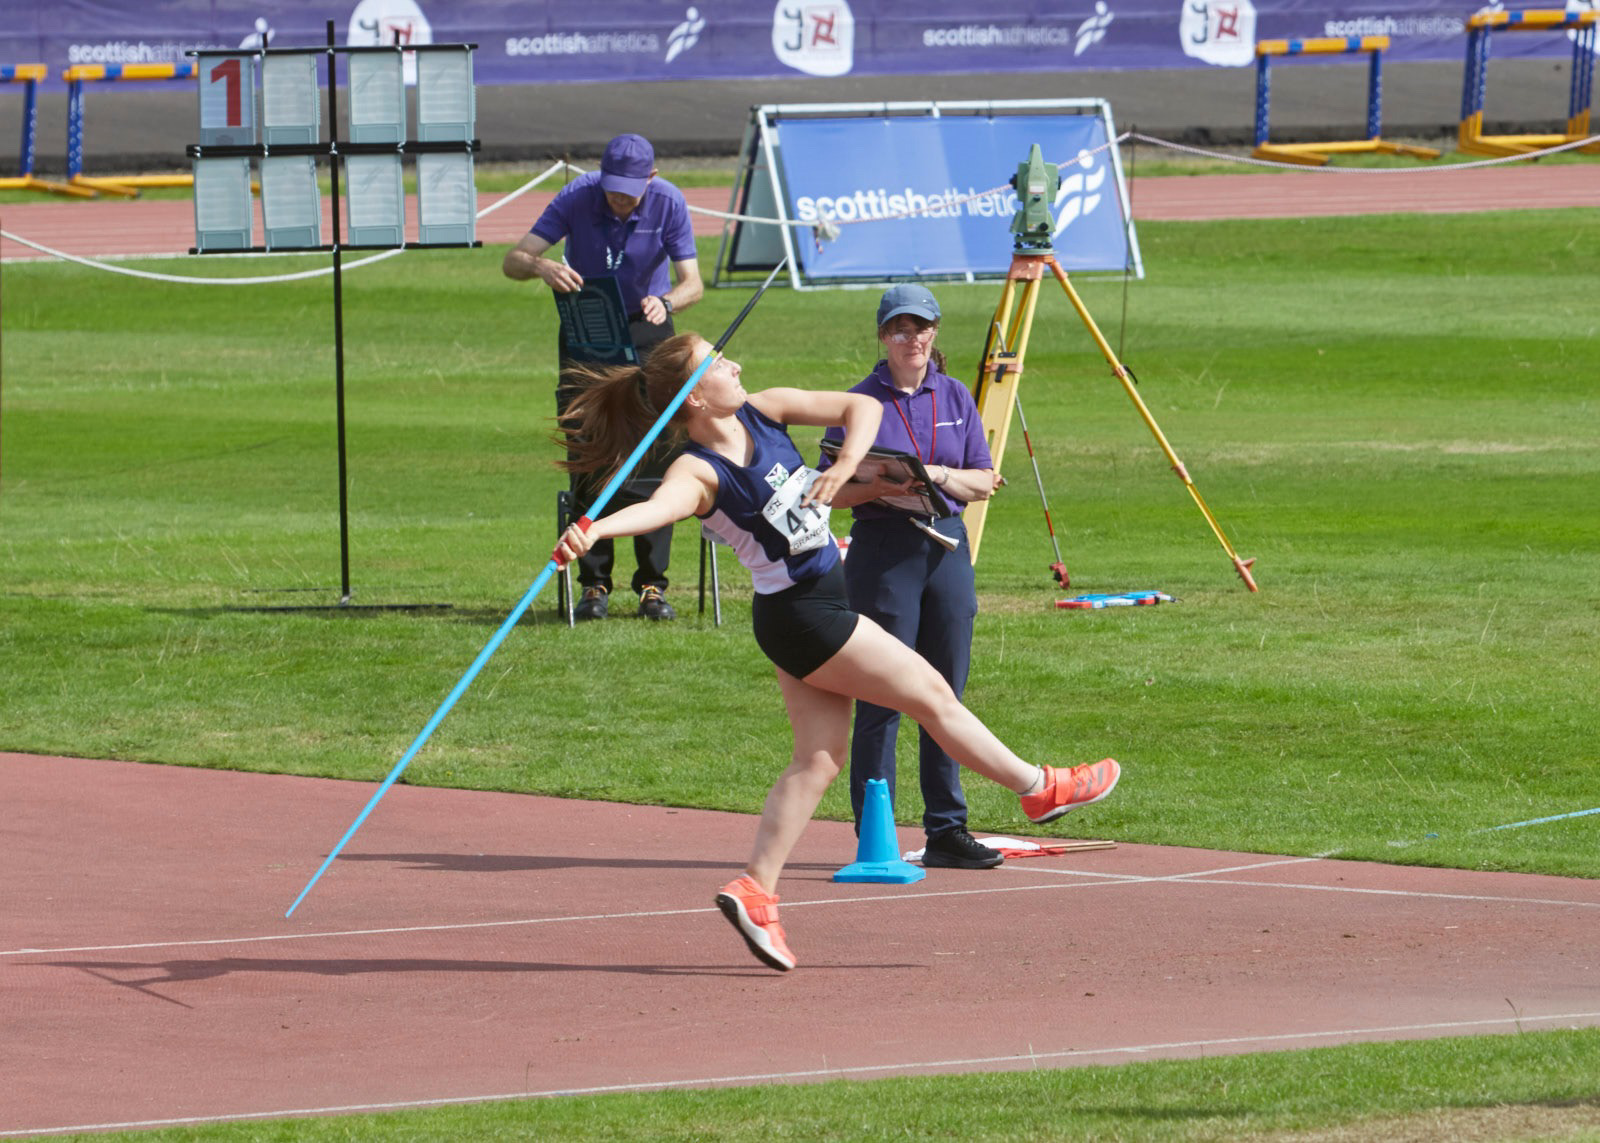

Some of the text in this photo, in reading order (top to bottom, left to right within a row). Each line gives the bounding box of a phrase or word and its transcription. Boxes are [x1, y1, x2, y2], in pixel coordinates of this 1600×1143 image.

[505, 32, 659, 56] scottishathletics
[922, 24, 1069, 46] scottishathletics
[211, 59, 241, 127] 1
[796, 187, 1018, 221] scottishathletic
[793, 520, 829, 551] GRANGE
